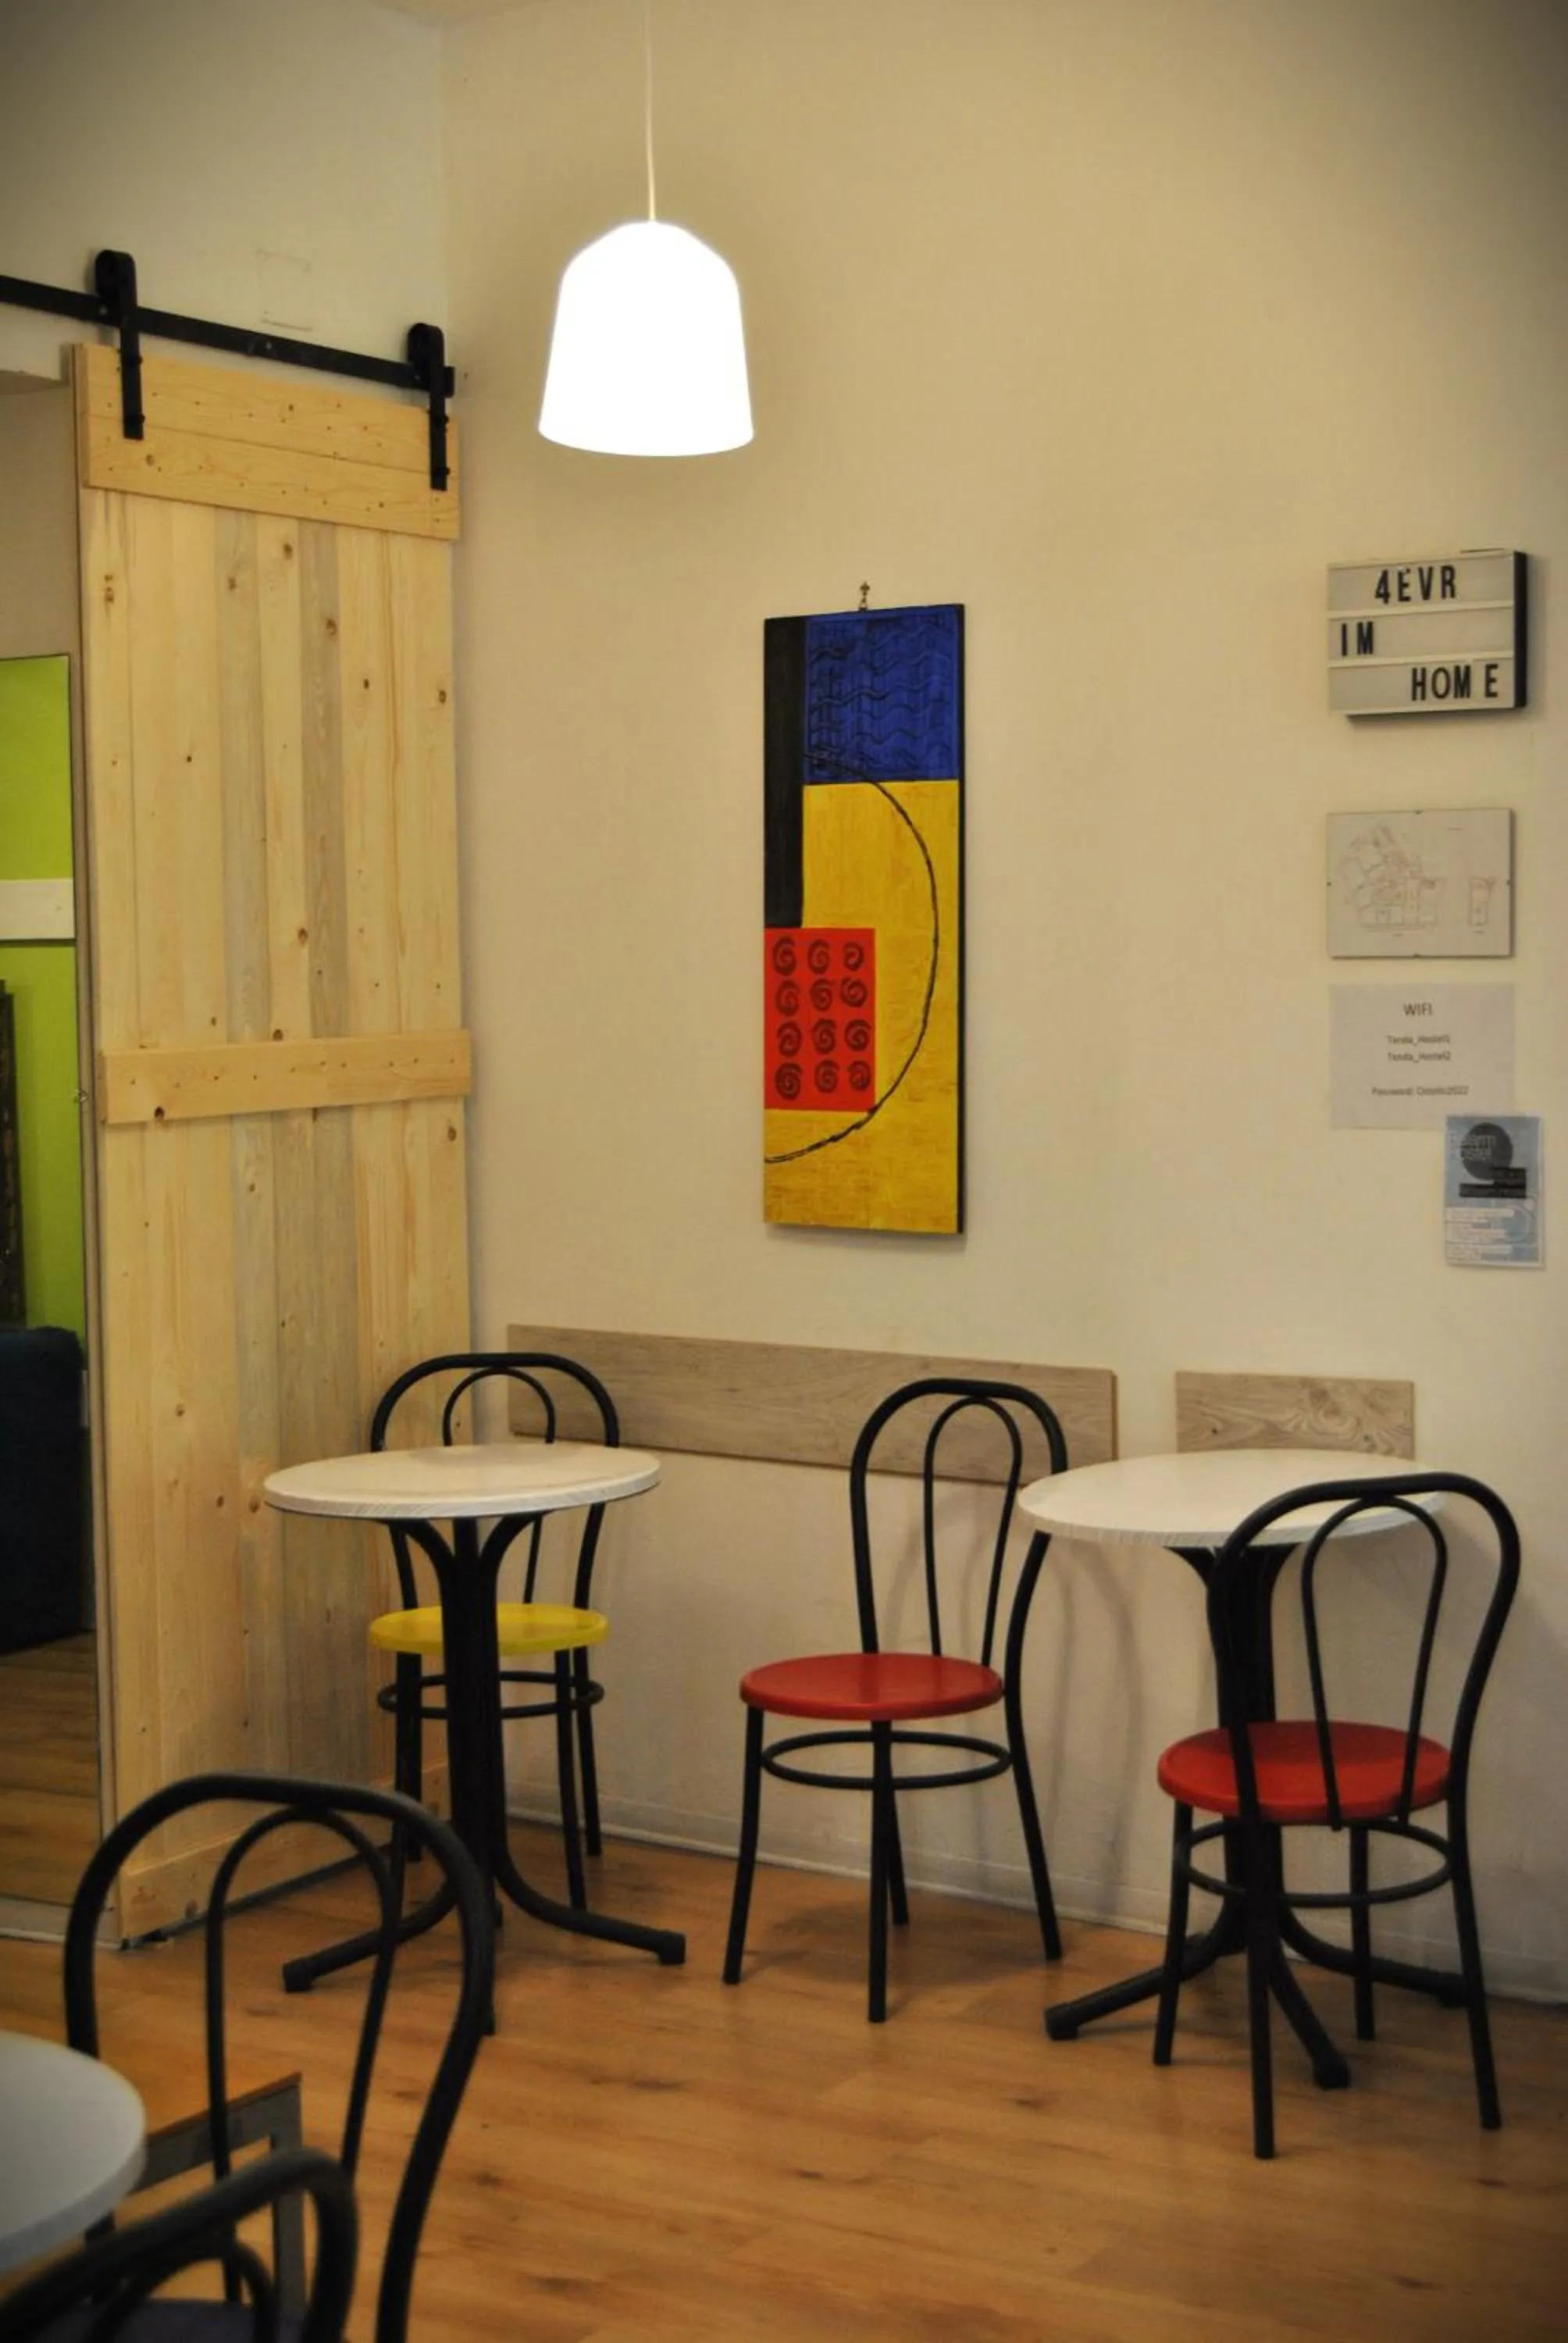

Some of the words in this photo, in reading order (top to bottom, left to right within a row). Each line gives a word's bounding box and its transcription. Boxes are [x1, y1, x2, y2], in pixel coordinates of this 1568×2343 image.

[1374, 565, 1456, 604] 4EVR
[1411, 663, 1499, 701] HOME
[1403, 1004, 1433, 1016] WIFI
